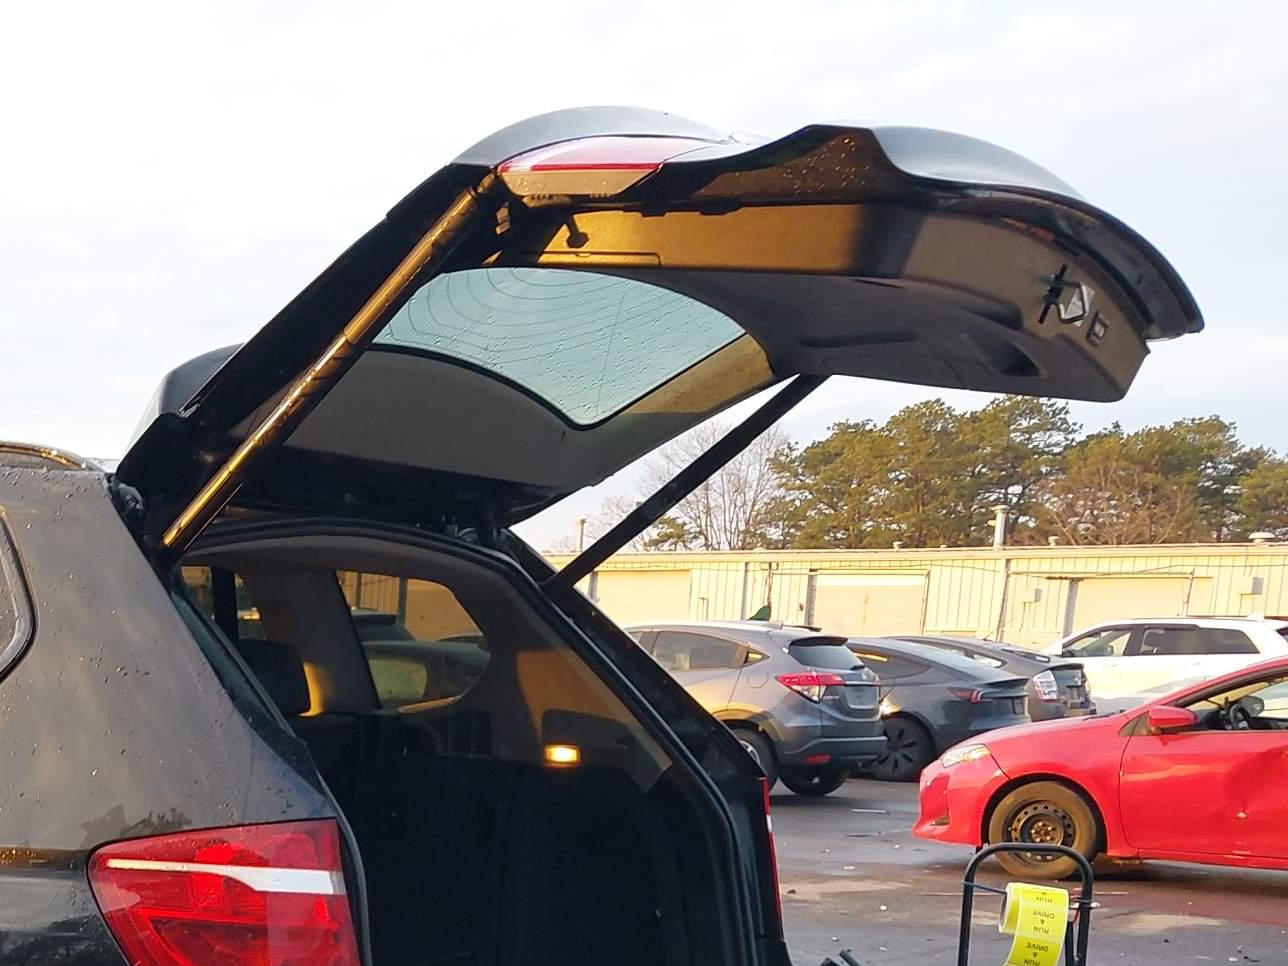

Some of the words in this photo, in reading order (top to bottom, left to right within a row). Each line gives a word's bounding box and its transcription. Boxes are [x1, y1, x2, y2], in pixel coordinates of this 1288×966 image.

[1032, 910, 1055, 919] DRIVE
[1033, 925, 1050, 934] RUN
[1025, 942, 1049, 952] DRIVE
[1023, 958, 1041, 966] RUN
